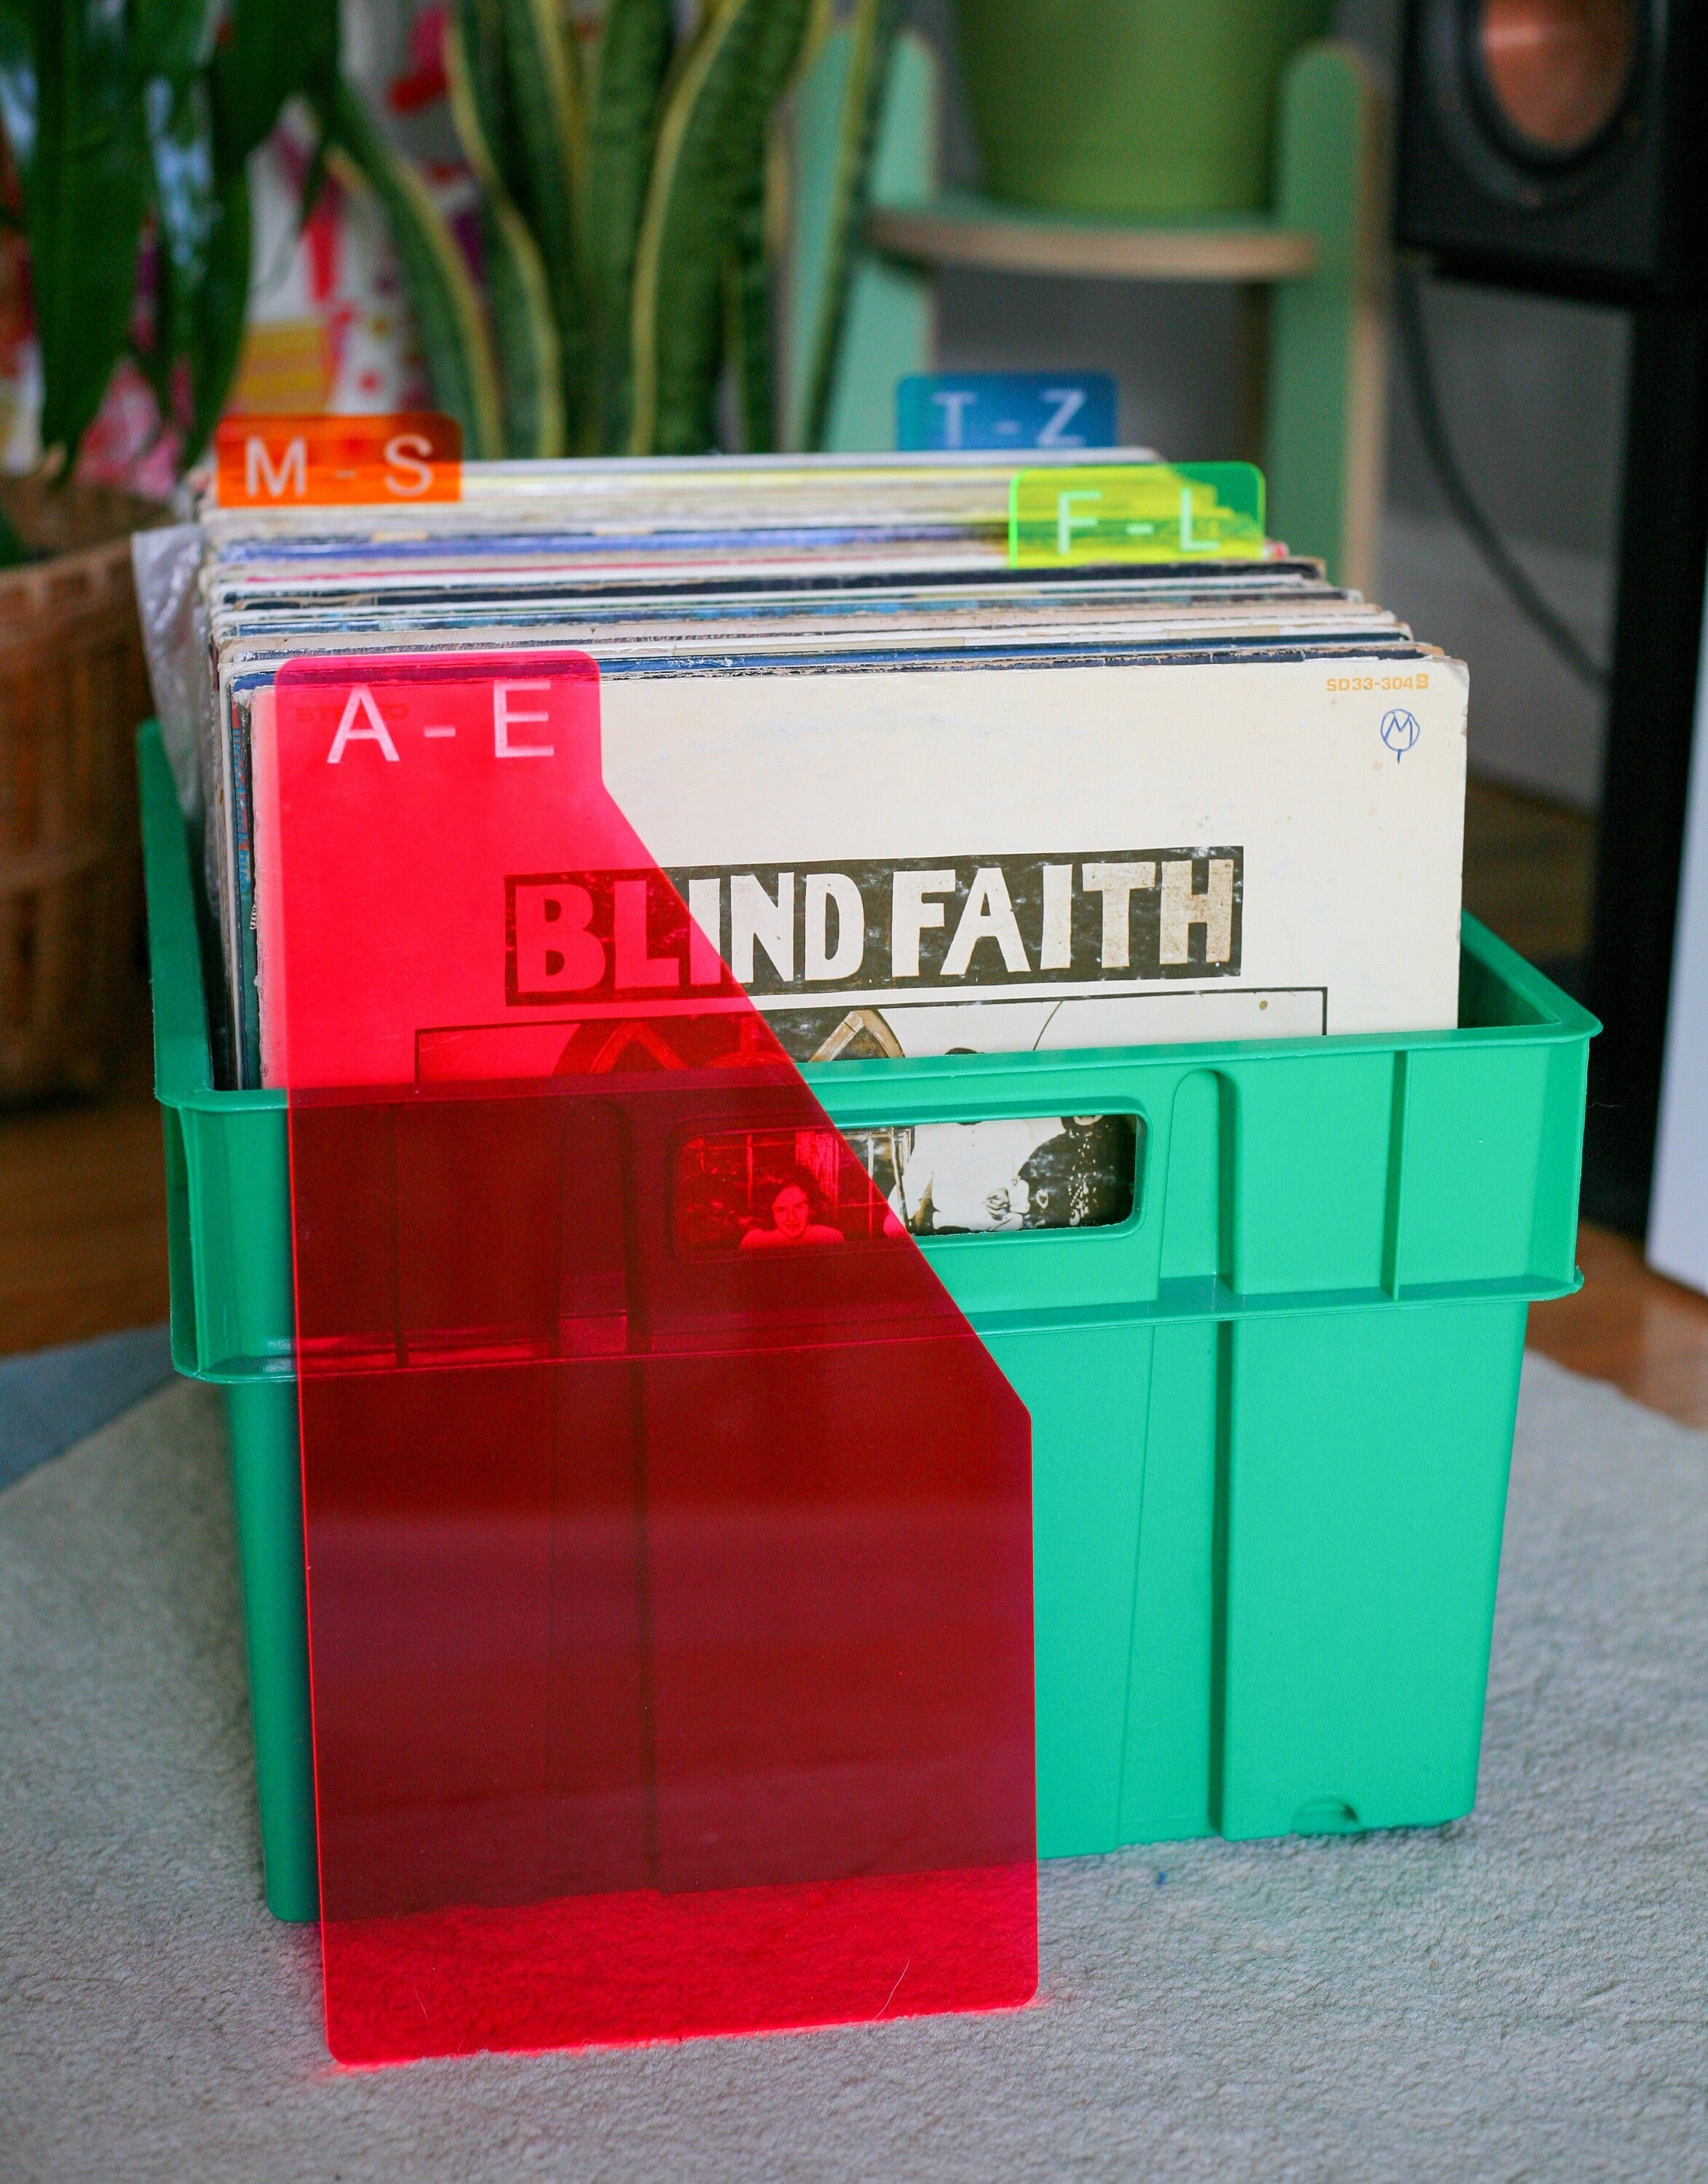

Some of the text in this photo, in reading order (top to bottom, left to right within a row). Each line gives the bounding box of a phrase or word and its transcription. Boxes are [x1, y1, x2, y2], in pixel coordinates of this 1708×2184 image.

[931, 390, 977, 447] T
[1037, 388, 1086, 446] Z
[245, 435, 307, 498] M
[384, 434, 433, 496] S
[1057, 490, 1102, 555] F
[1179, 486, 1219, 552] L
[326, 684, 400, 764] A
[494, 679, 554, 758] E
[515, 859, 1234, 992] BLIND FAITH
